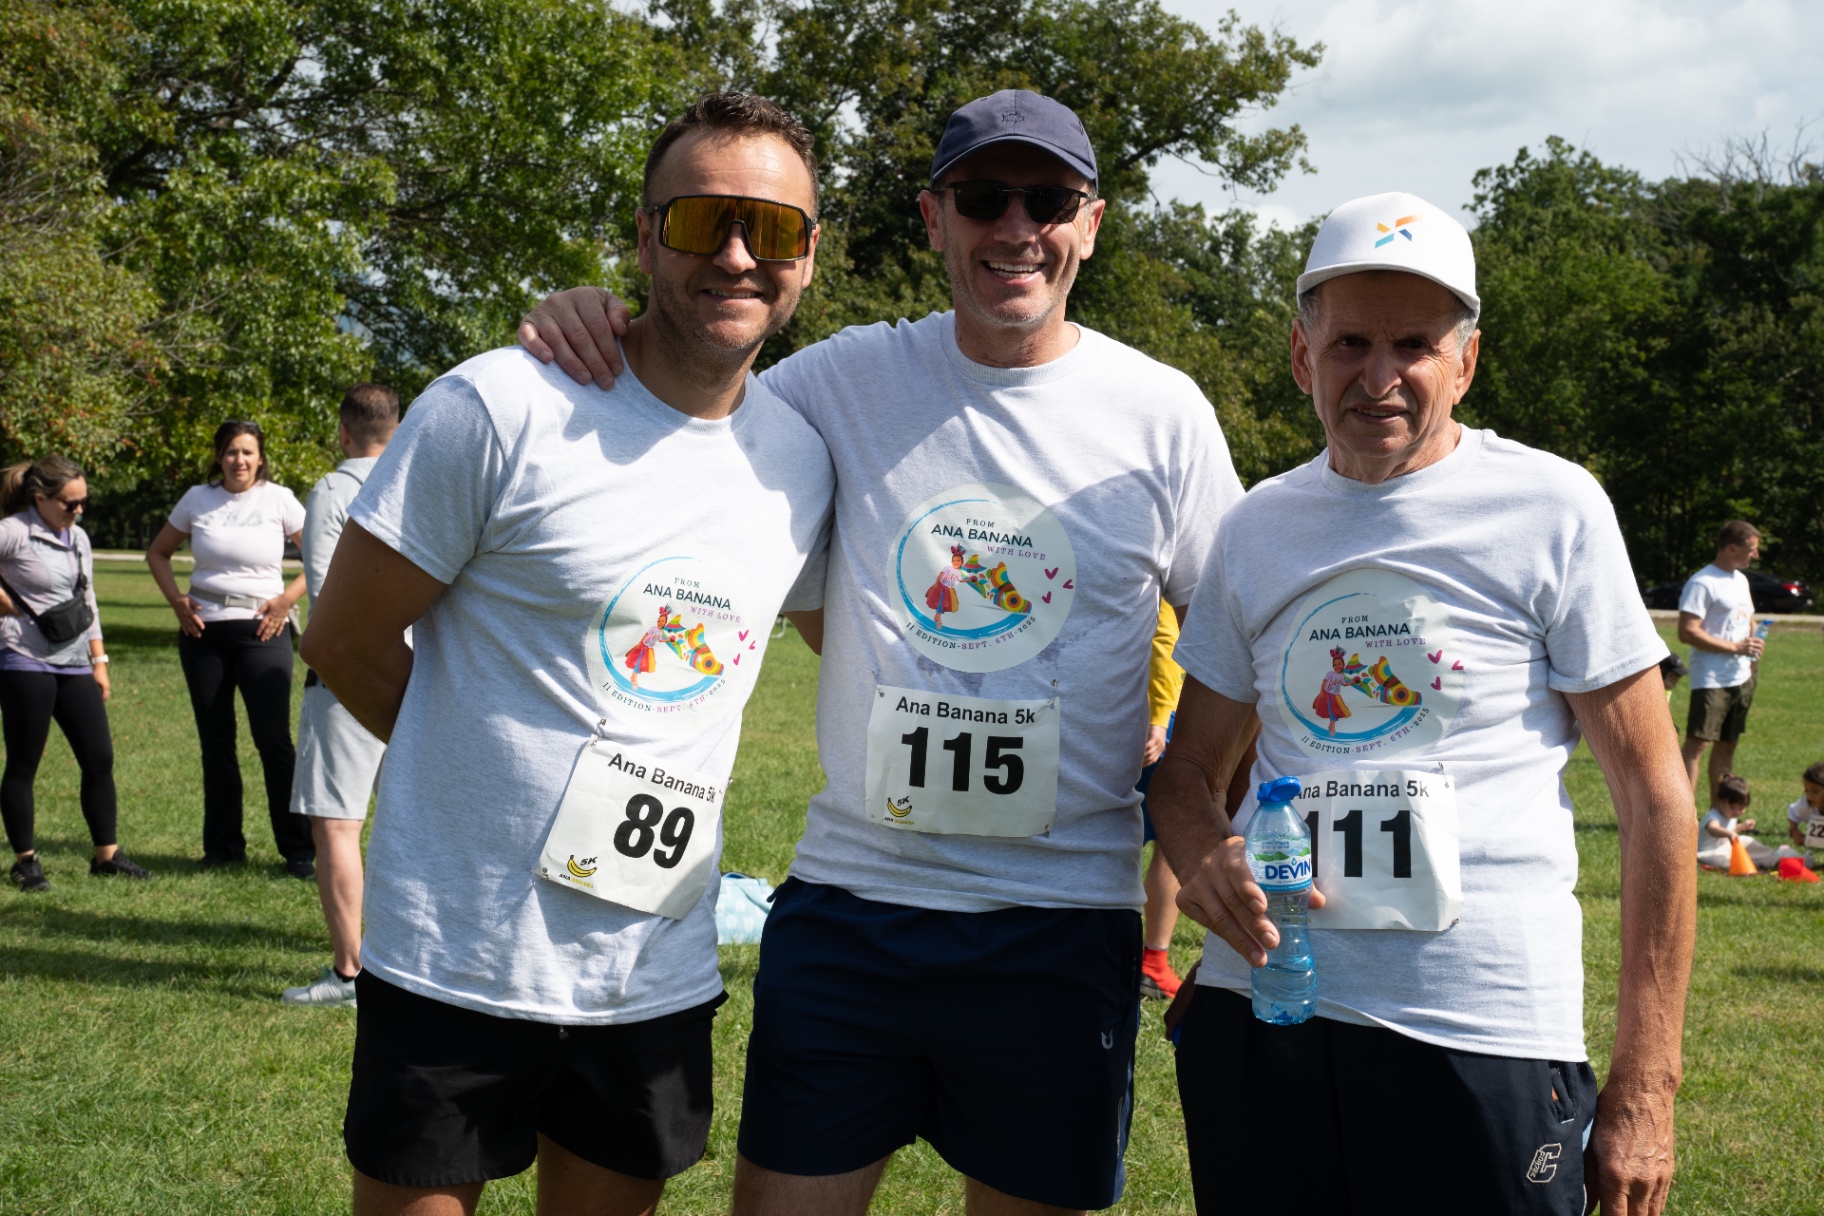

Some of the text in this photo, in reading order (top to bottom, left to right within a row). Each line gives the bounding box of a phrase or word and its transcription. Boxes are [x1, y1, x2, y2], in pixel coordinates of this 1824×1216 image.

[965, 518, 995, 529] FROM
[931, 524, 1034, 548] ANA BANANA
[987, 545, 1047, 561] WITH LOVE
[674, 577, 701, 588] FROM
[643, 583, 732, 611] ANA BANANA
[690, 606, 742, 623] WITH LOVE
[1341, 615, 1369, 624] FROM
[1309, 622, 1411, 642] ANA BANANA
[1365, 637, 1426, 649] WITH LOVE
[895, 696, 1036, 725] Ana Banana 5k
[901, 726, 1025, 795] 115
[608, 753, 647, 779] Ana
[651, 767, 706, 800] Banana
[1292, 780, 1430, 800] Ana Banana 5k
[897, 795, 910, 806] 5K
[613, 793, 696, 869] 89
[580, 856, 598, 866] 5K
[1265, 859, 1311, 880] DEVIN
